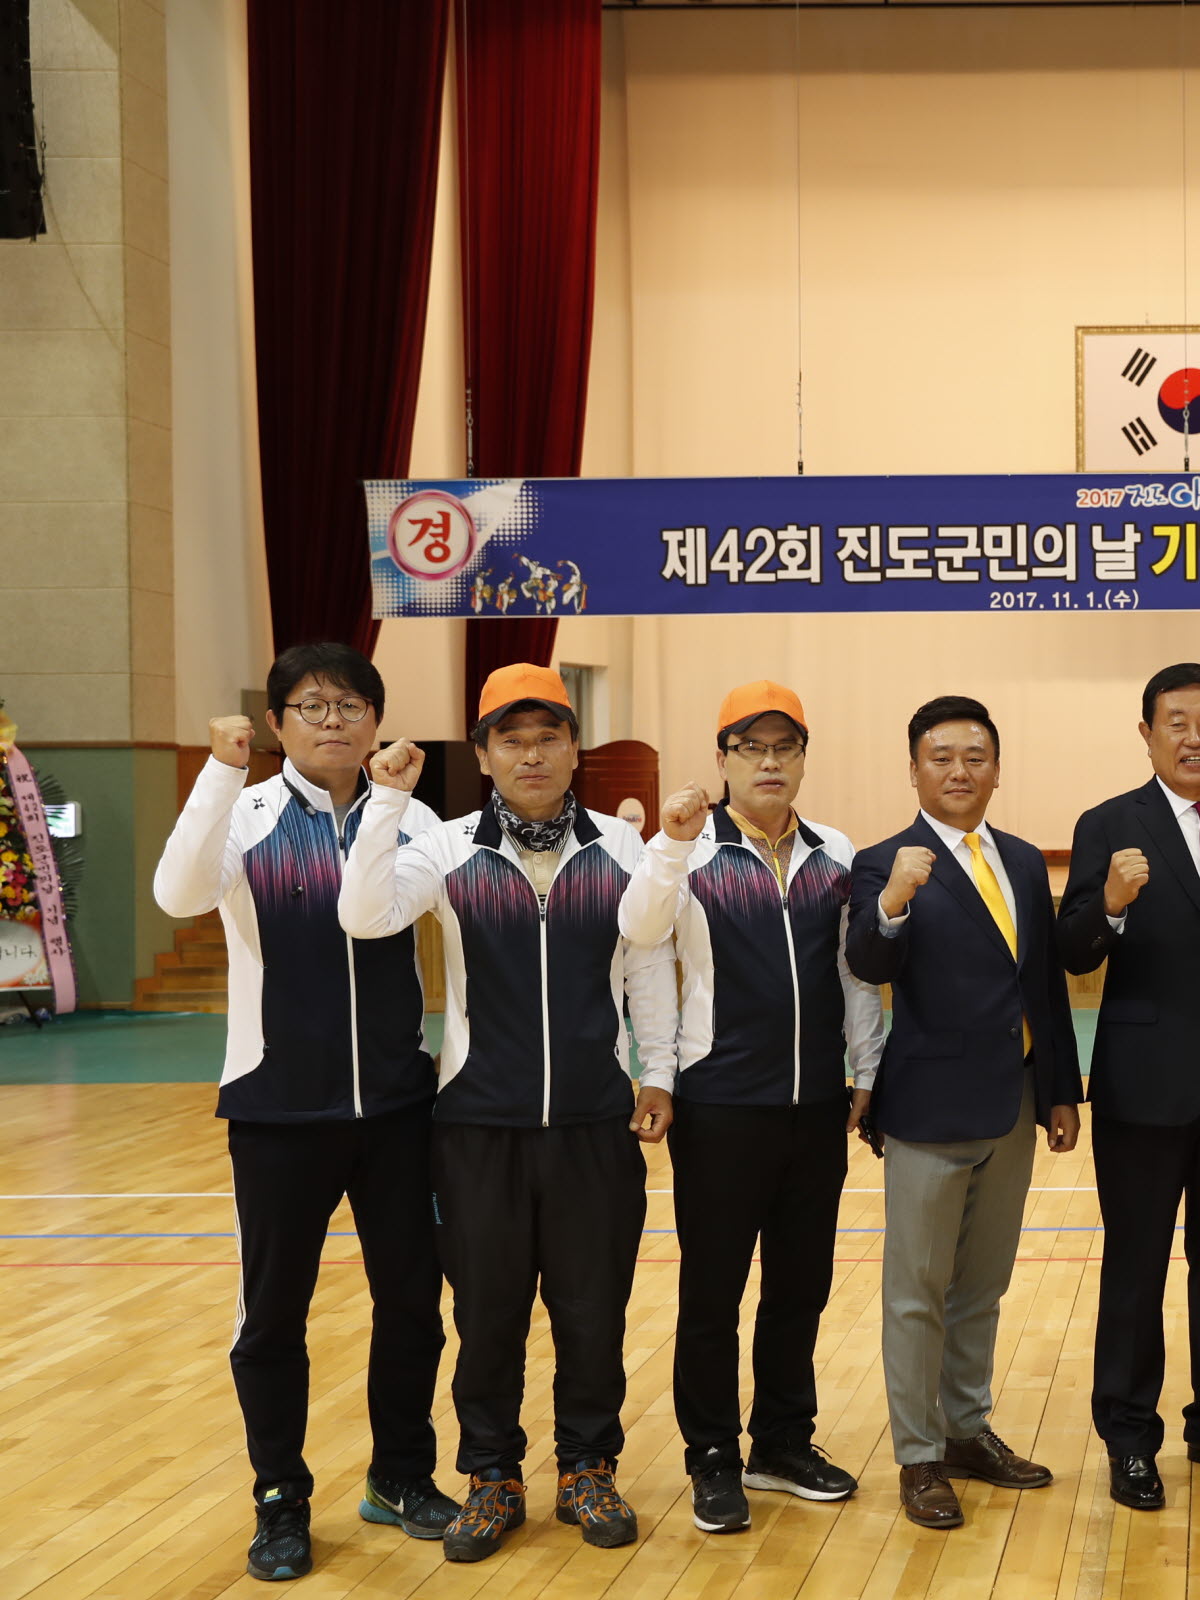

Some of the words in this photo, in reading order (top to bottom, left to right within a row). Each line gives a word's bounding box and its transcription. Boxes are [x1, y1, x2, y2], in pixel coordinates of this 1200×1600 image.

[1077, 489, 1125, 507] 2017
[407, 510, 451, 564] 경
[662, 525, 820, 584] 제42회
[837, 525, 1076, 581] 진도군민의
[1093, 524, 1140, 579] 날
[990, 592, 1044, 608] 2017.
[1053, 592, 1078, 608] 11.
[0, 944, 38, 960] 니다.
